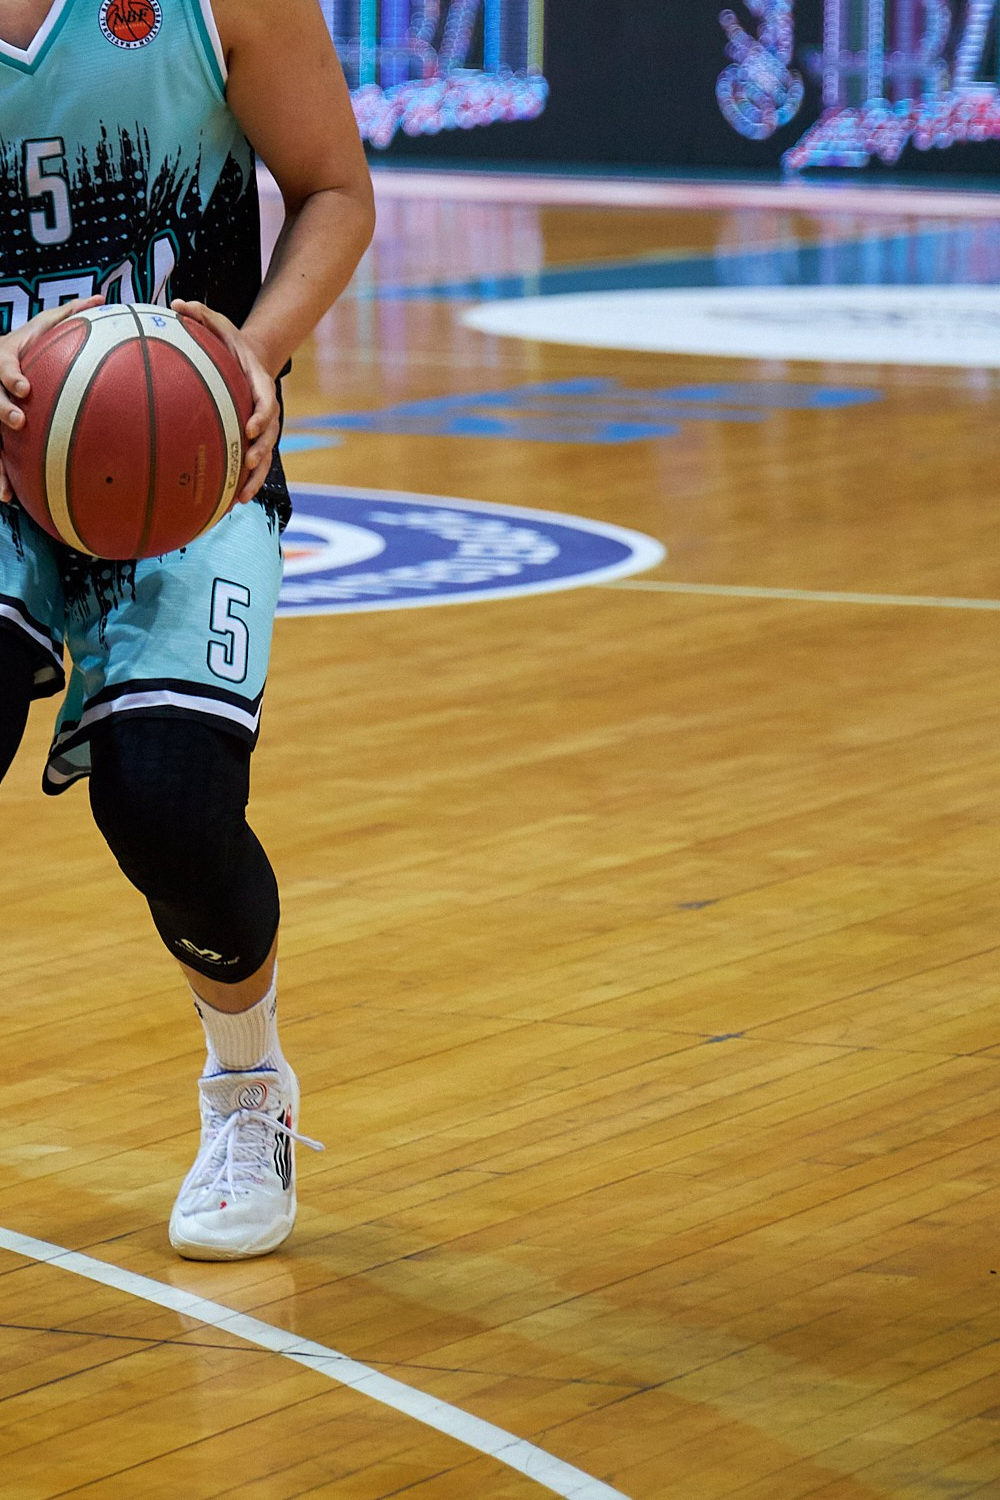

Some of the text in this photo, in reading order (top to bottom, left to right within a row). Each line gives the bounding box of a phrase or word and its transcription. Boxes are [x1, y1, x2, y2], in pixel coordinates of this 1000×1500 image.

[100, 16, 131, 48] NATIONAL
[113, 7, 149, 25] NBF
[22, 136, 73, 244] 5
[207, 577, 250, 683] 5
